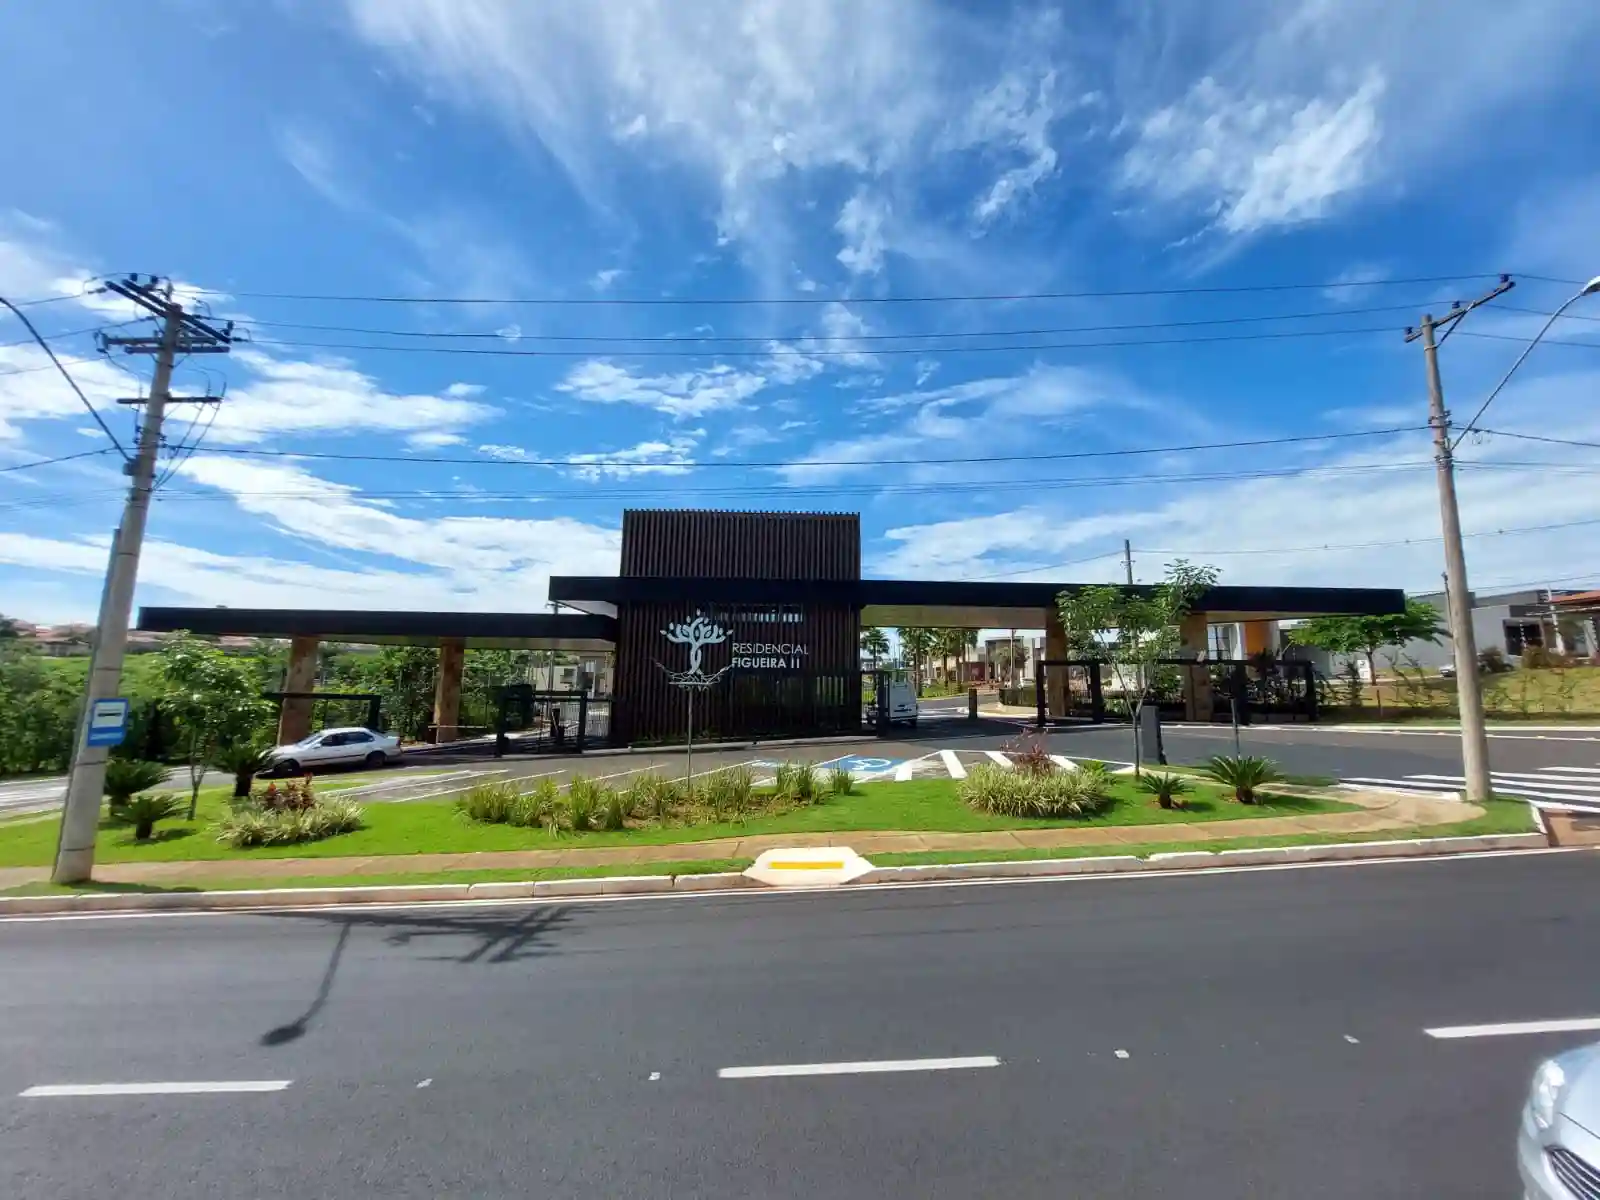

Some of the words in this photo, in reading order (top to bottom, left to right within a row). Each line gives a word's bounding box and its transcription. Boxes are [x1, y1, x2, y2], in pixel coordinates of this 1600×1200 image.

[732, 643, 809, 655] RESIDENCIAL
[731, 657, 787, 669] FIGUEIRA
[791, 657, 800, 669] II
